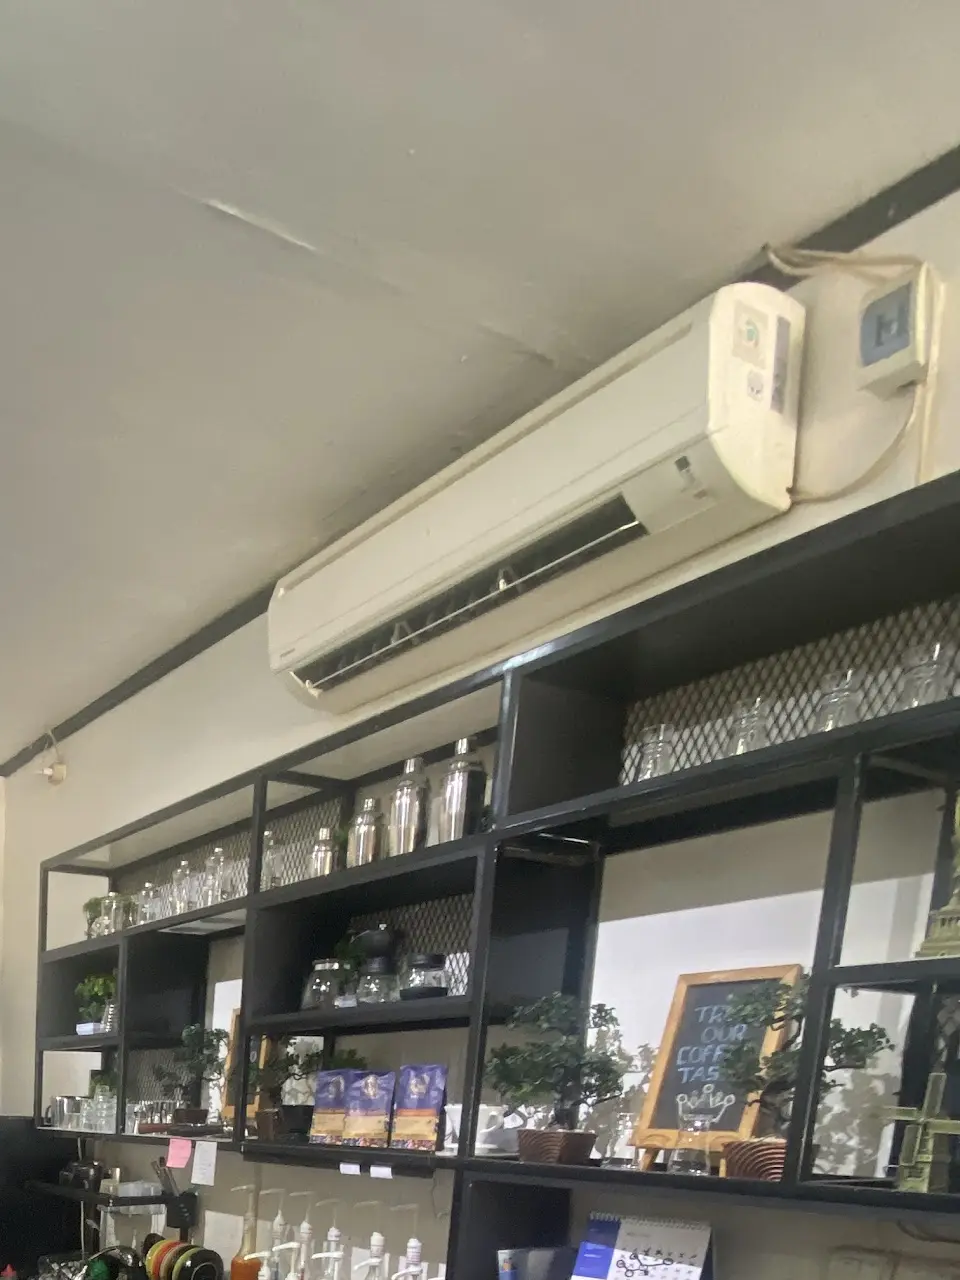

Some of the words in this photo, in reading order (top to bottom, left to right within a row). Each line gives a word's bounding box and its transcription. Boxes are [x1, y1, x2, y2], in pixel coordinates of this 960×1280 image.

[694, 1004, 732, 1023] TR
[700, 1024, 748, 1042] OUR
[676, 1044, 729, 1066] COFF
[677, 1065, 721, 1084] TAS
